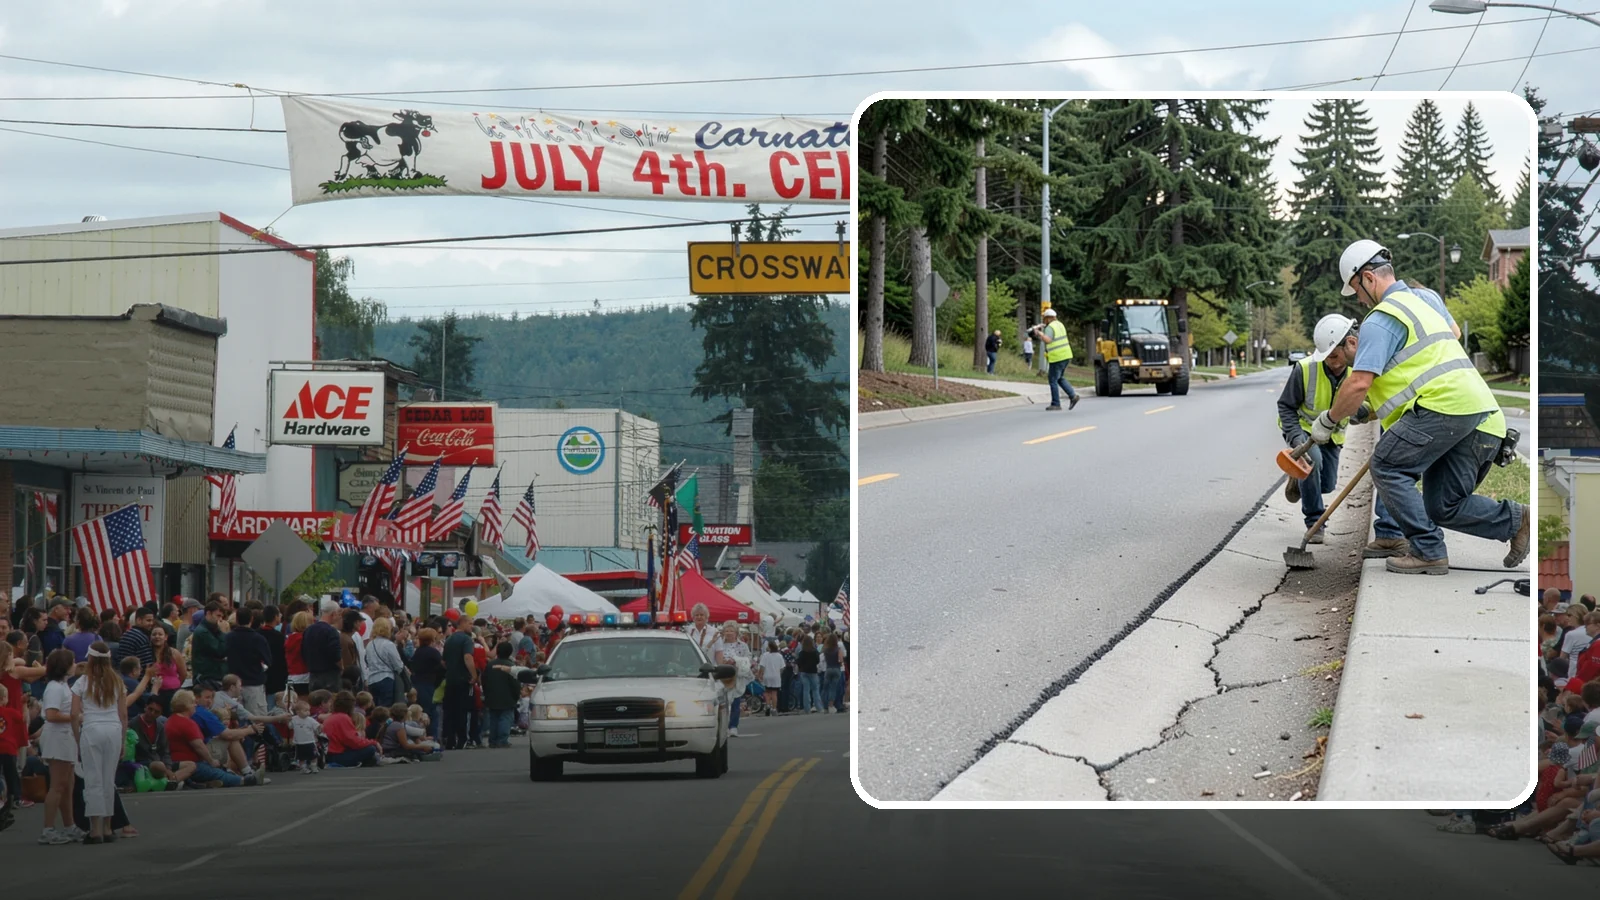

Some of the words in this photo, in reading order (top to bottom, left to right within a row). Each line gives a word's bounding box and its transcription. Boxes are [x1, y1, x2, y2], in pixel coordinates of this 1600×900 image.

[481, 140, 605, 192] JULY
[632, 149, 746, 198] 4th.
[696, 254, 850, 280] CROSSWA
[282, 380, 373, 420] ACE
[406, 409, 452, 422] CEDAR
[461, 409, 485, 421] LOG
[283, 421, 371, 436] Hardware
[416, 428, 476, 447] Coca-Cola
[353, 467, 385, 480] Simpl
[95, 485, 124, 495] Vincent
[126, 486, 135, 495] de
[138, 486, 155, 495] Paul
[81, 503, 153, 522] THT
[213, 516, 330, 535] HARDARE
[688, 527, 741, 535] CRNATION
[699, 535, 730, 543] GLASS
